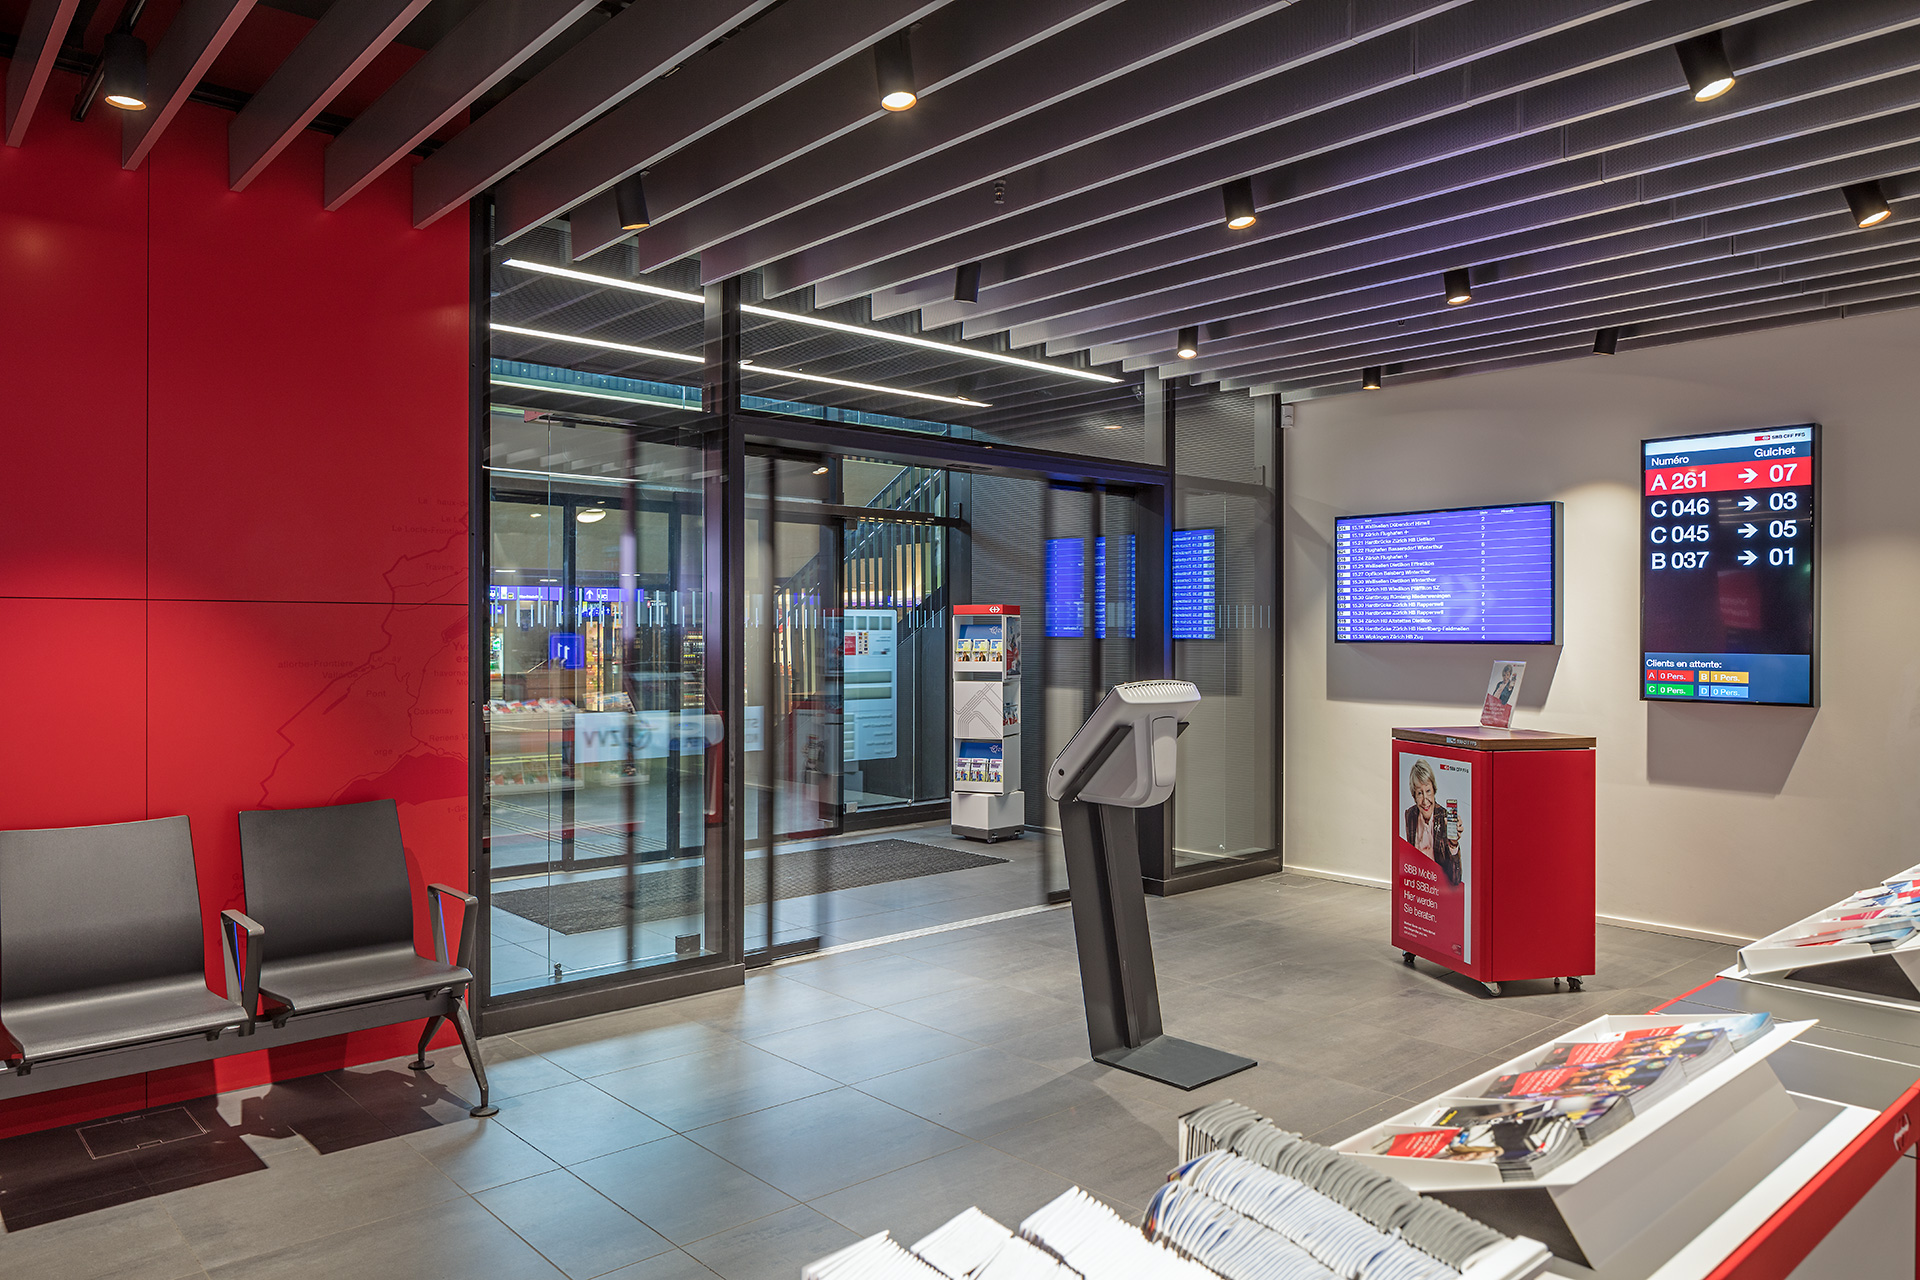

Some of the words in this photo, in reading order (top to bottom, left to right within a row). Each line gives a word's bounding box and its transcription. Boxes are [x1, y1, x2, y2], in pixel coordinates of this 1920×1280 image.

[1754, 445, 1796, 458] Guichet
[1651, 455, 1690, 466] Numéro
[1650, 474, 1667, 491] A
[1671, 470, 1707, 490] 261
[1769, 463, 1797, 482] 07
[1650, 500, 1667, 518] C
[1671, 498, 1710, 517] 046
[1769, 492, 1797, 511] 03
[1650, 526, 1667, 544] C
[1671, 524, 1710, 543] 045
[1769, 520, 1797, 539] 05
[1650, 553, 1667, 570] B
[1671, 551, 1710, 569] 037
[1769, 547, 1794, 566] 01
[425, 563, 454, 571] Travers
[1646, 659, 1674, 667] Clients
[1689, 660, 1722, 668] attente:
[1720, 674, 1740, 682] Pers.
[366, 690, 386, 698] Pont
[413, 708, 454, 717] Cossonay
[429, 734, 459, 742] Renens
[1404, 863, 1417, 875] SBB
[1418, 867, 1438, 882] Mobile
[1404, 878, 1415, 888] und
[1416, 880, 1440, 896] SBB.ch:
[1404, 890, 1416, 901] Hier
[1416, 895, 1438, 909] werden
[1404, 902, 1413, 914] Sie
[1414, 907, 1437, 923] beraten.
